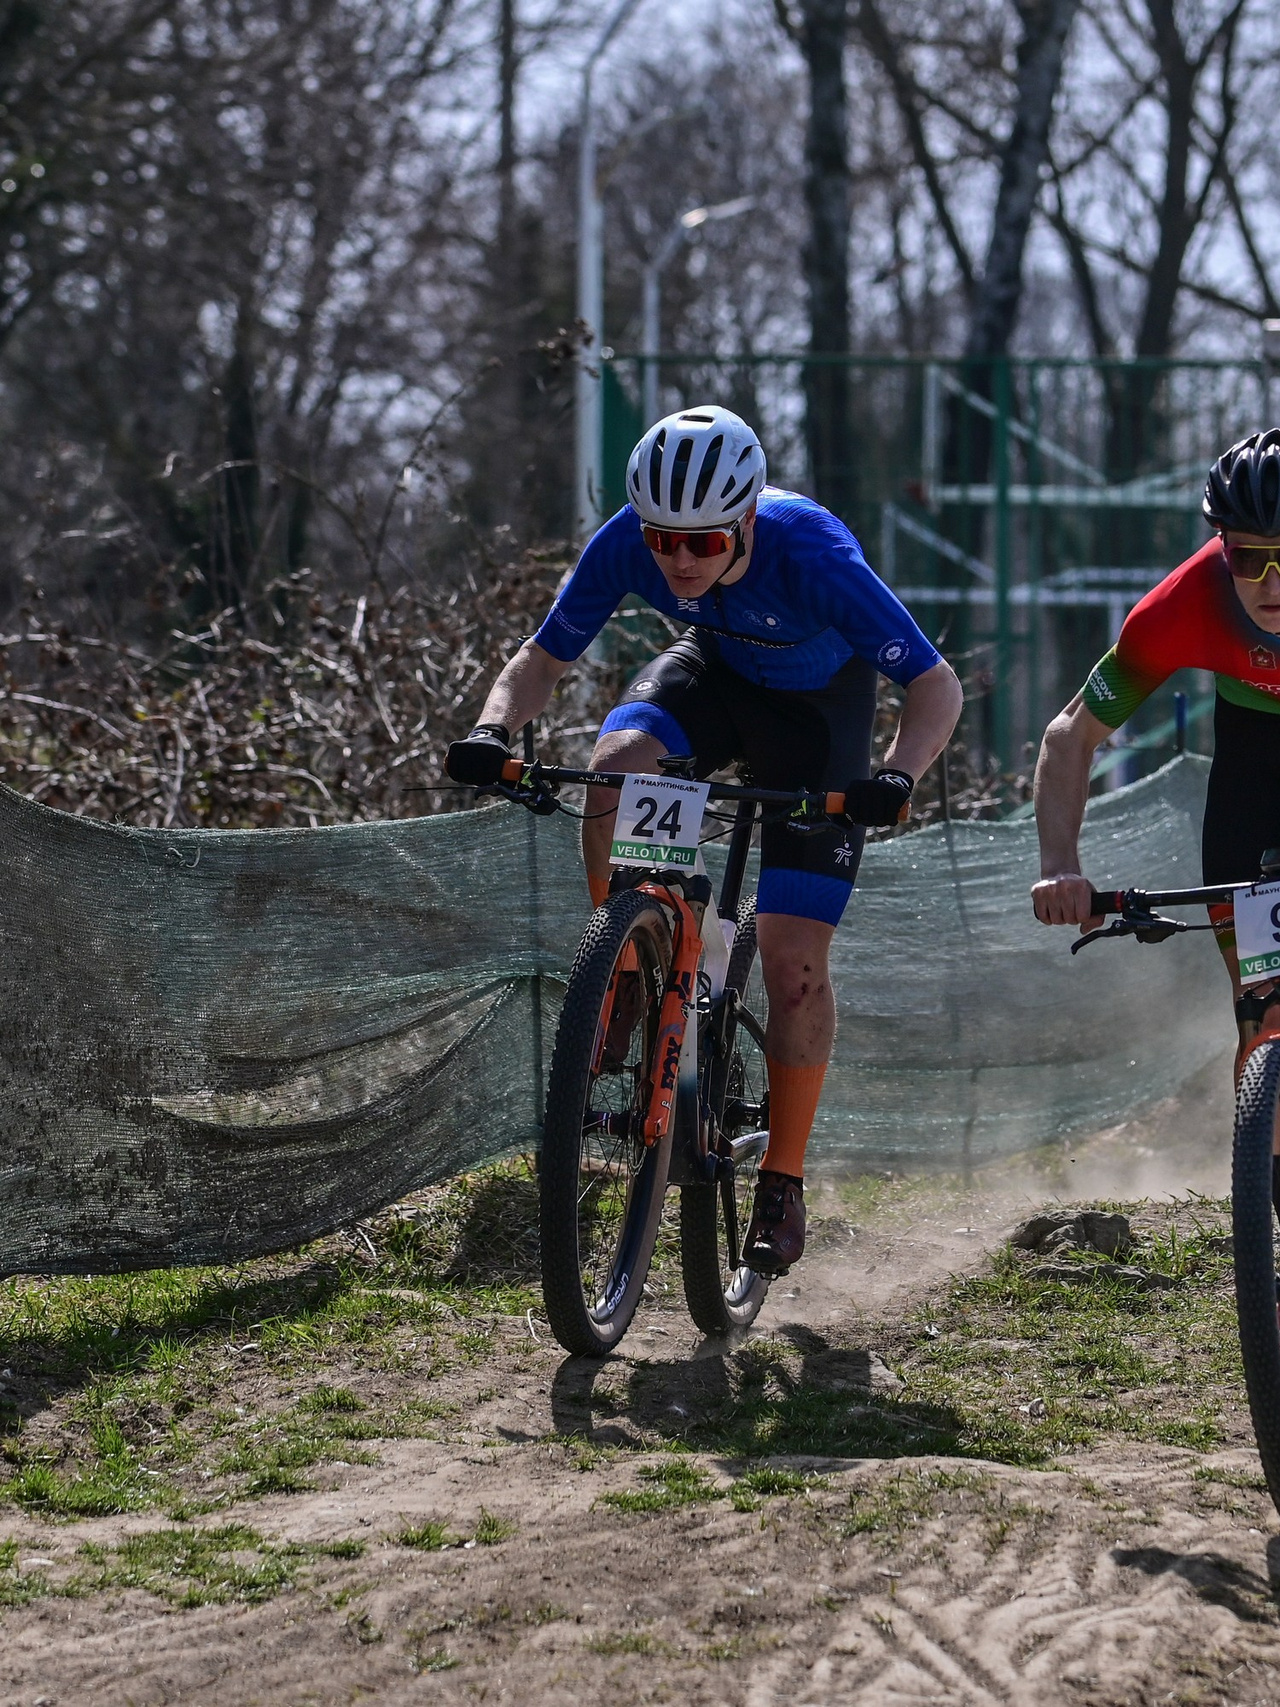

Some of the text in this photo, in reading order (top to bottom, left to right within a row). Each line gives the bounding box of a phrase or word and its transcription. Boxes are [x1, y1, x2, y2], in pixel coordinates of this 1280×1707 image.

[1089, 677, 1105, 702] GION
[1092, 669, 1117, 701] SCOW
[631, 796, 682, 840] 24
[617, 845, 691, 862] VELOTV.RU
